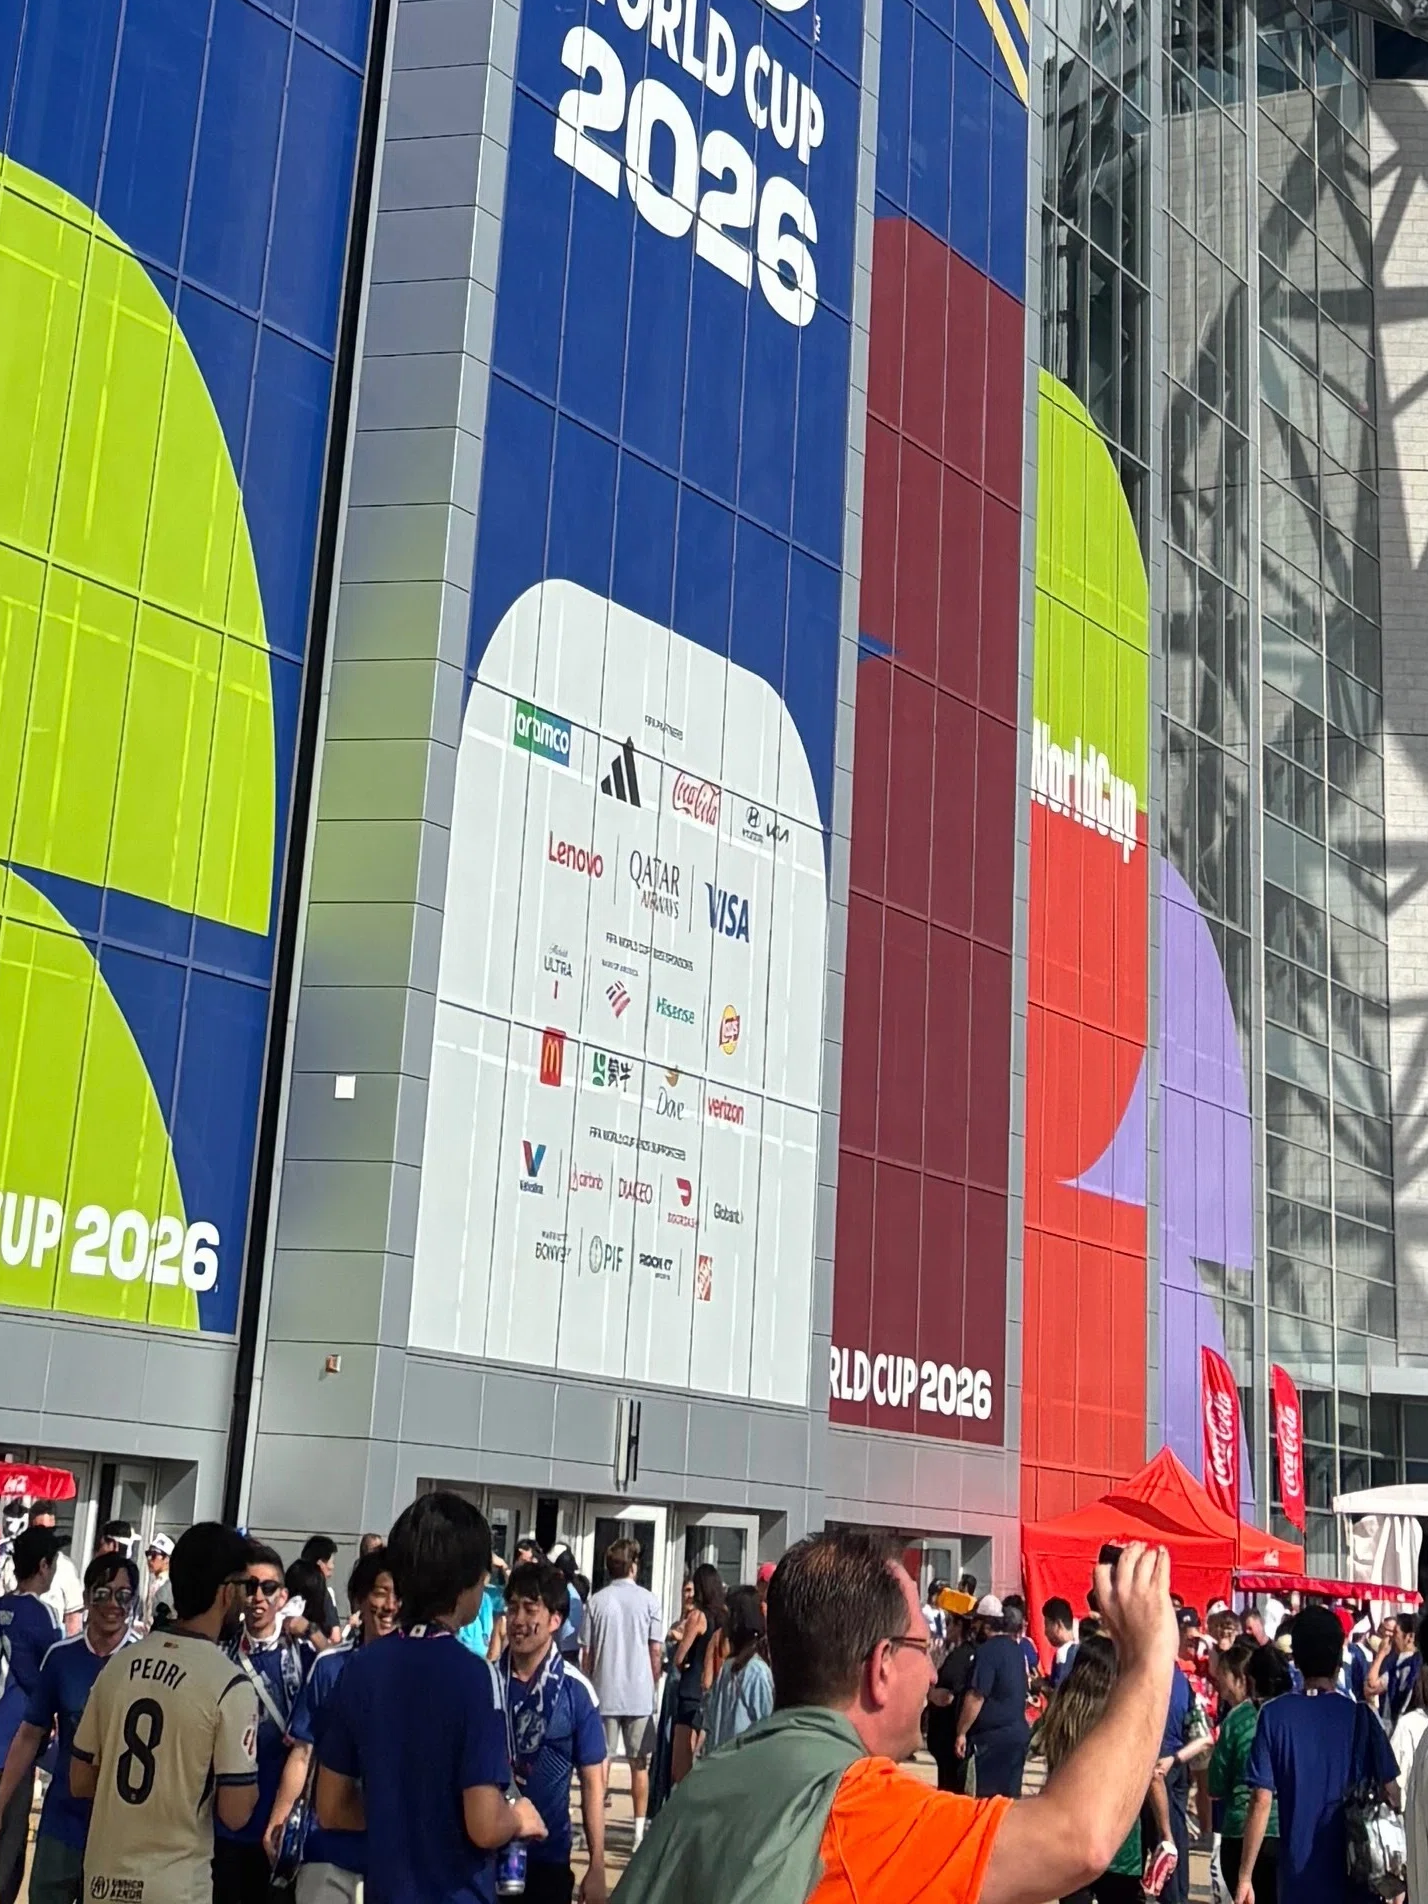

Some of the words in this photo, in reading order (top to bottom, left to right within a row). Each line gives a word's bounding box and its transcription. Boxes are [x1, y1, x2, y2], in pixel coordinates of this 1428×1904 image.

[744, 43, 825, 166] CUP
[553, 25, 818, 327] 2026
[515, 711, 569, 755] aramco
[548, 830, 604, 879] Lenovo
[629, 850, 680, 897] QATAR
[704, 881, 750, 944] VISA
[656, 995, 695, 1025] Hisense
[707, 1095, 745, 1126] verizon
[69, 1204, 221, 1292] 2026
[603, 1243, 625, 1273] PIF
[872, 1352, 919, 1408] CUP
[919, 1360, 993, 1421] 2026
[129, 1657, 188, 1691] PEDRI
[116, 1697, 165, 1806] 8
